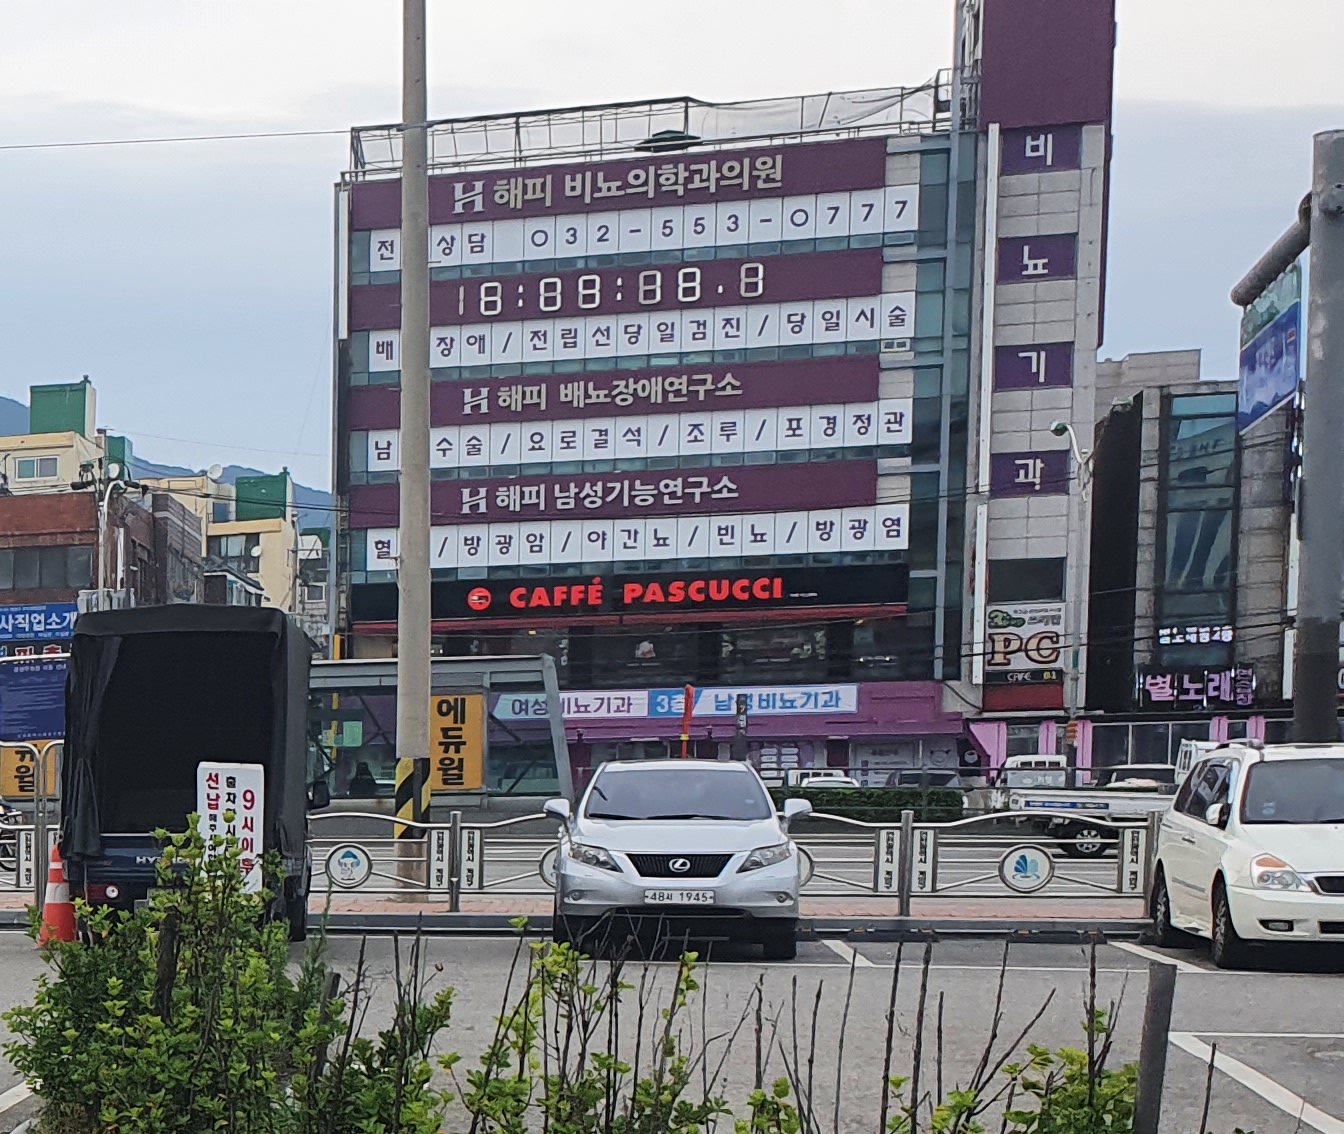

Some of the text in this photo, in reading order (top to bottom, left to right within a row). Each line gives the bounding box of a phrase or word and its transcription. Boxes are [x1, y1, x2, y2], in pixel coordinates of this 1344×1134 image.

[493, 175, 552, 210] 해피
[564, 154, 784, 204] 비뇨의학과의원
[1014, 132, 1053, 491] 비뇨기과
[497, 383, 547, 412] 해피
[560, 372, 744, 409] 배뇨장애연구소
[495, 483, 546, 512] 해피
[554, 474, 740, 510] 남성기능연구소
[510, 577, 784, 609] CAFFÉ PASCUCCI
[987, 630, 1061, 667] PC
[436, 697, 467, 786] 에듀윌
[206, 773, 220, 811] 선납
[679, 891, 708, 902] 1945
